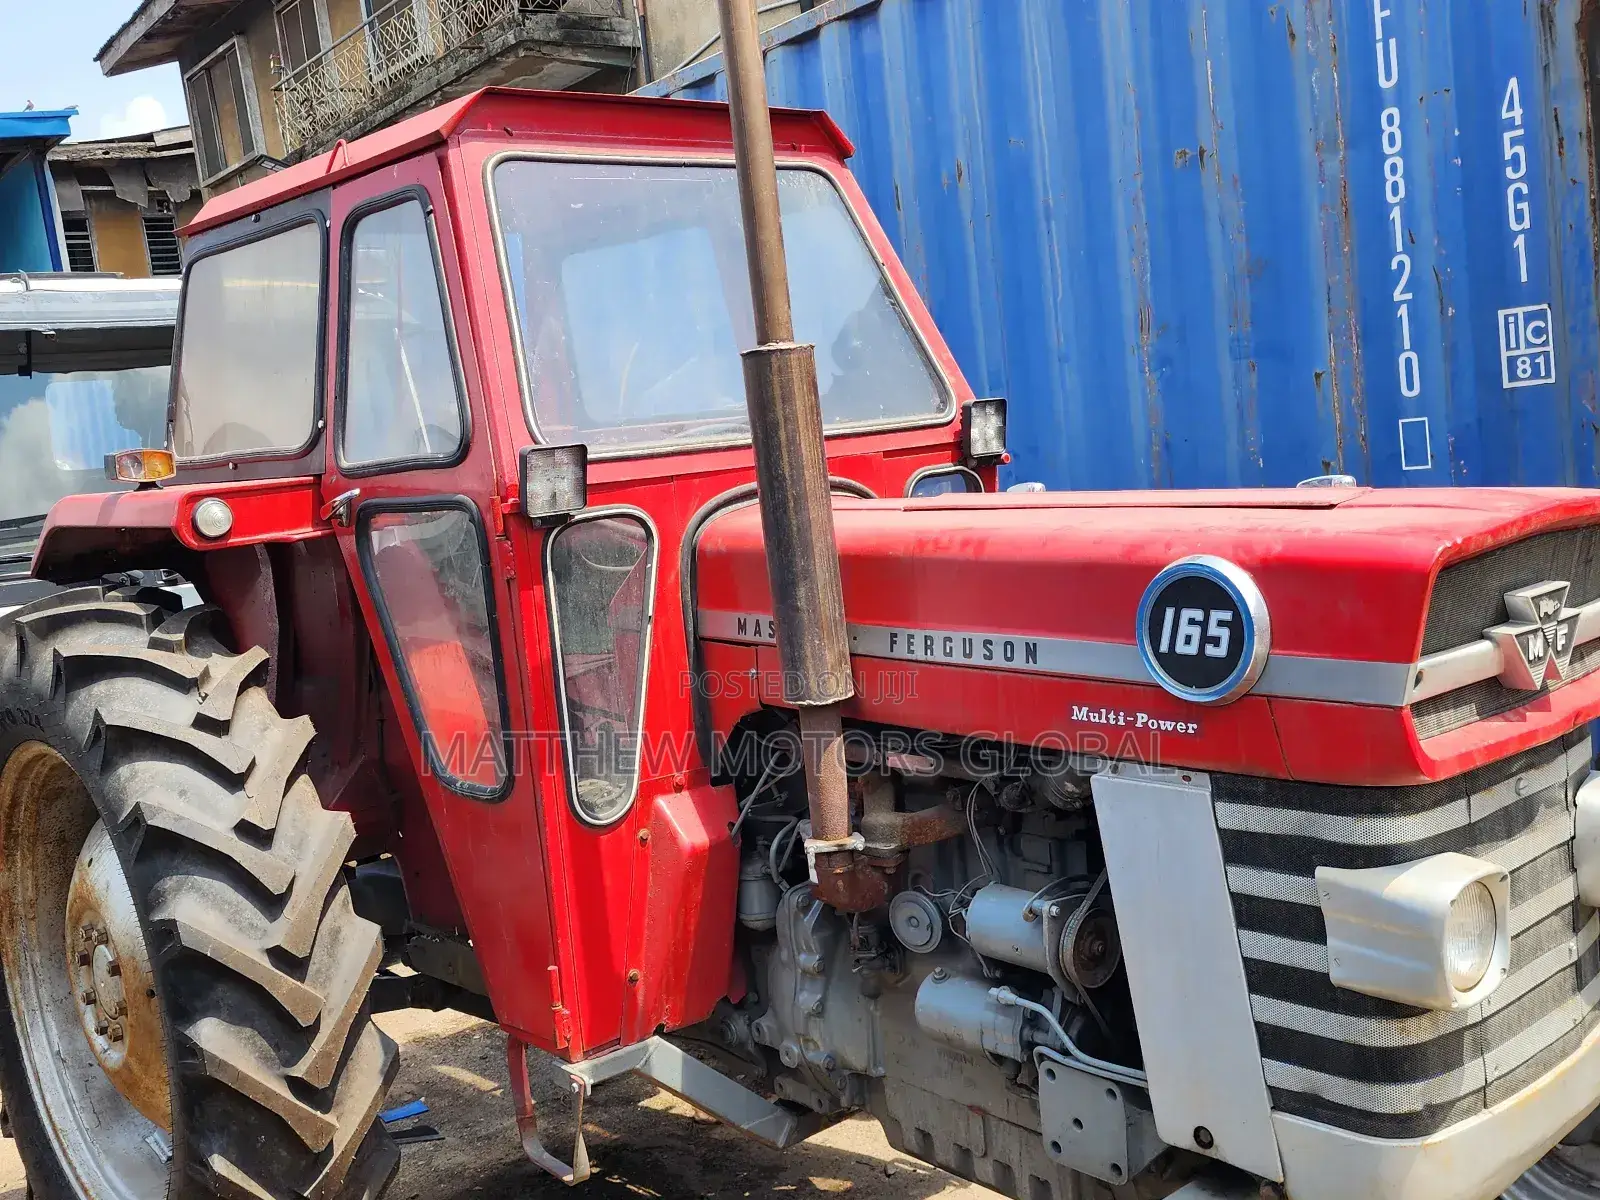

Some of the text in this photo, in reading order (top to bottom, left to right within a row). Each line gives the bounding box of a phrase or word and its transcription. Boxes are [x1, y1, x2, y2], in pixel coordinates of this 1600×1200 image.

[1501, 76, 1532, 283] 45G1
[1381, 107, 1421, 398] 881210
[1516, 354, 1547, 379] 81
[889, 632, 1038, 665] FERGUSON
[1158, 606, 1234, 659] 165
[1071, 705, 1198, 734] Multi-Power
